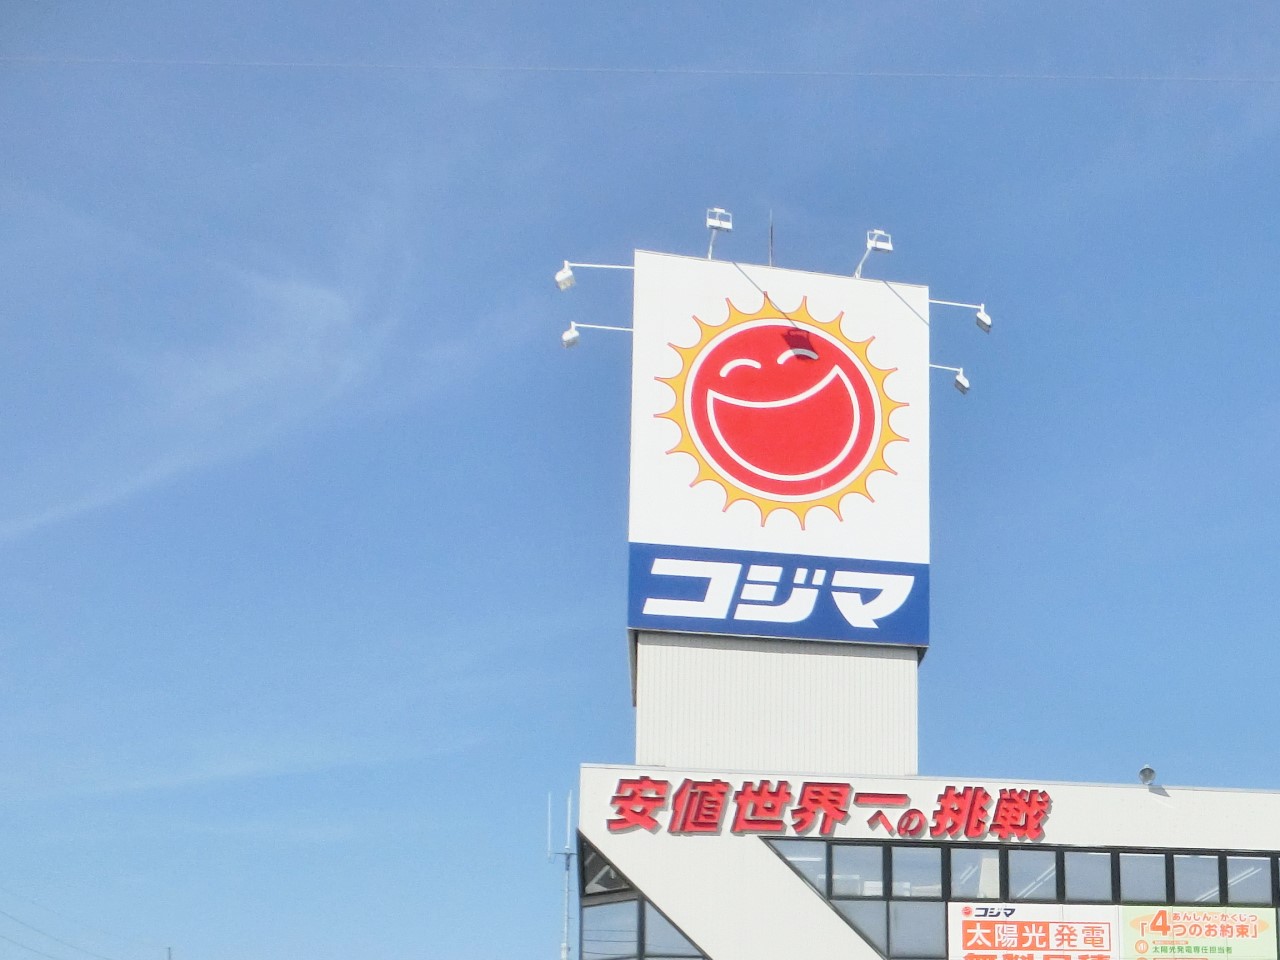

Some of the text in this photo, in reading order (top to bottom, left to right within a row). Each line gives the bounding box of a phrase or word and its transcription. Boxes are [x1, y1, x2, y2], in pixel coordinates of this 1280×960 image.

[642, 557, 915, 629] コジマ
[605, 775, 1053, 841] 安値世界一への挑戦
[974, 907, 1015, 917] コジマ
[1172, 912, 1258, 922] あんしん・かくじつ
[966, 922, 1105, 948] 太陽光発電
